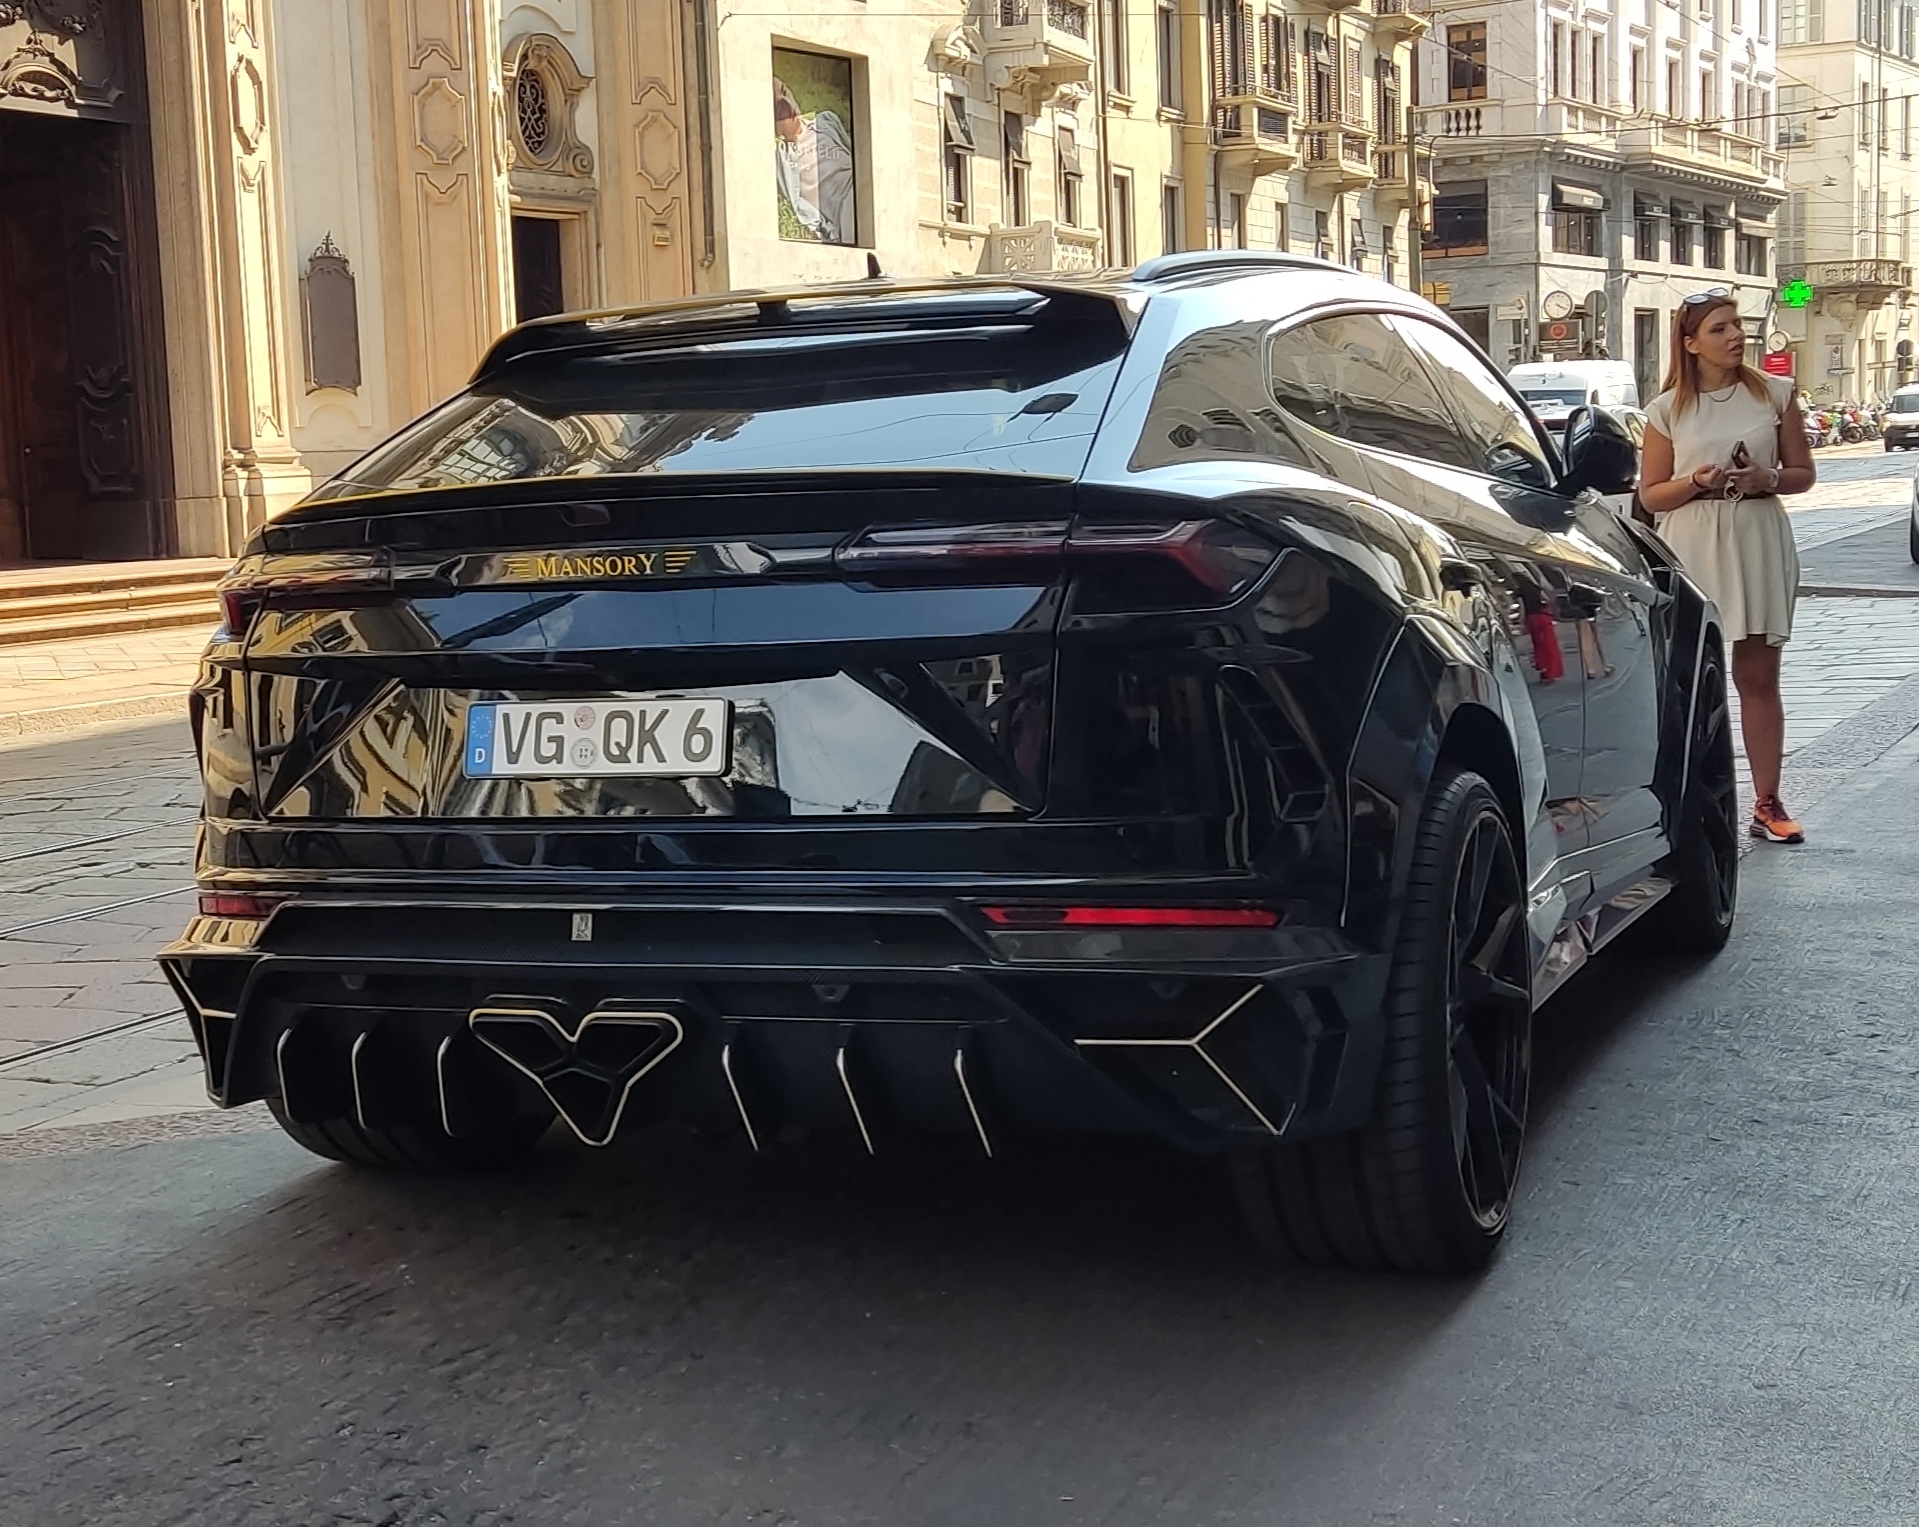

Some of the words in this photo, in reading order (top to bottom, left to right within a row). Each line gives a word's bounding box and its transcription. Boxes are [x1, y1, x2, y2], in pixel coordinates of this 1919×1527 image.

[536, 553, 657, 578] MANSORY
[502, 711, 565, 765] VG
[603, 708, 670, 764] QK
[683, 708, 713, 763] 6
[474, 748, 486, 764] D
